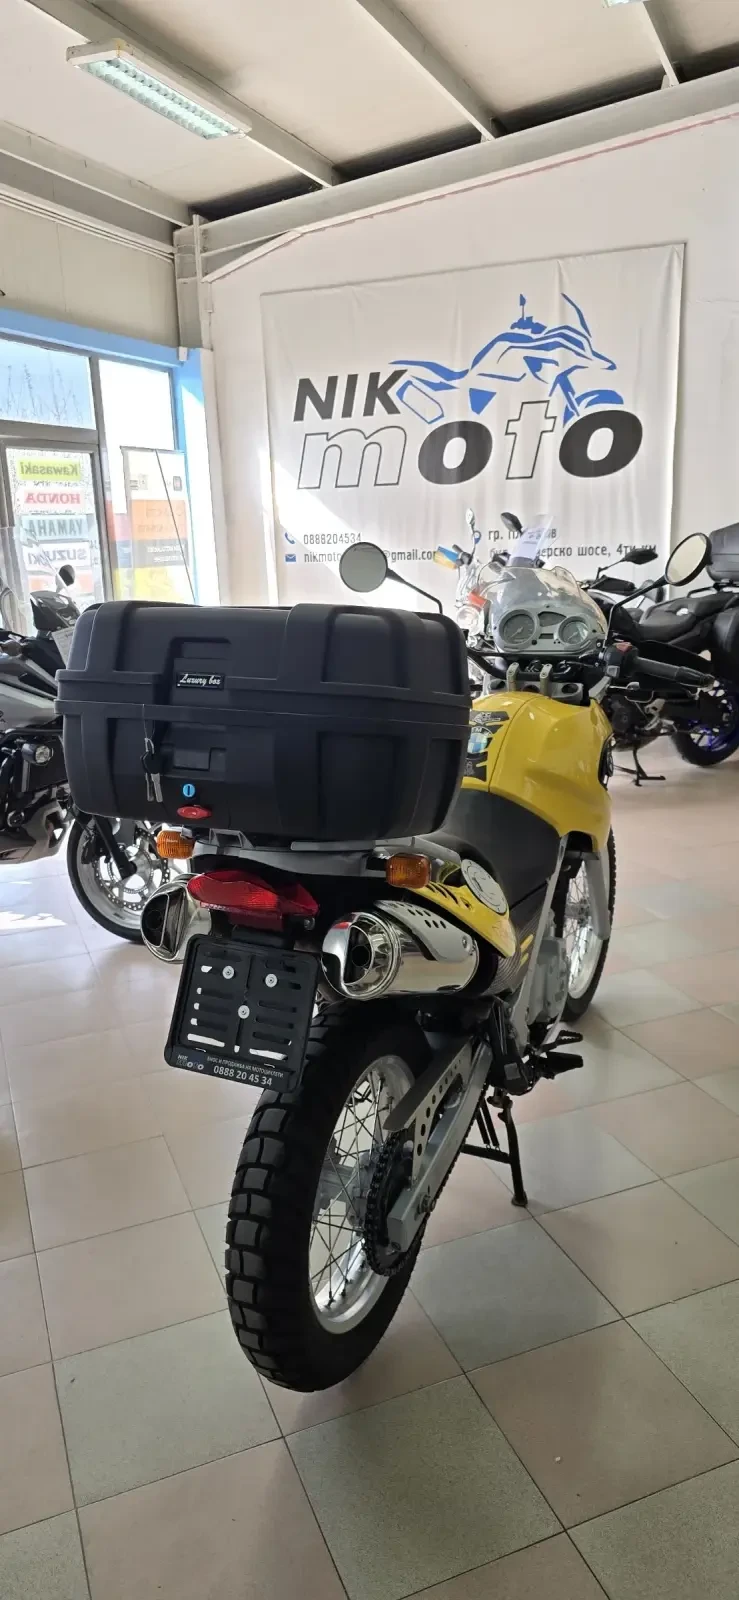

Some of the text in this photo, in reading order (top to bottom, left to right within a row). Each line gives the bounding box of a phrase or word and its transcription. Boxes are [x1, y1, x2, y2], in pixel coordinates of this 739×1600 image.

[293, 369, 408, 422] NIK
[297, 400, 643, 489] moto
[303, 532, 362, 545] 0888204534
[488, 529, 504, 543] гр.
[577, 544, 611, 558] шосе,
[213, 1065, 273, 1086] 0888 20 45 34
